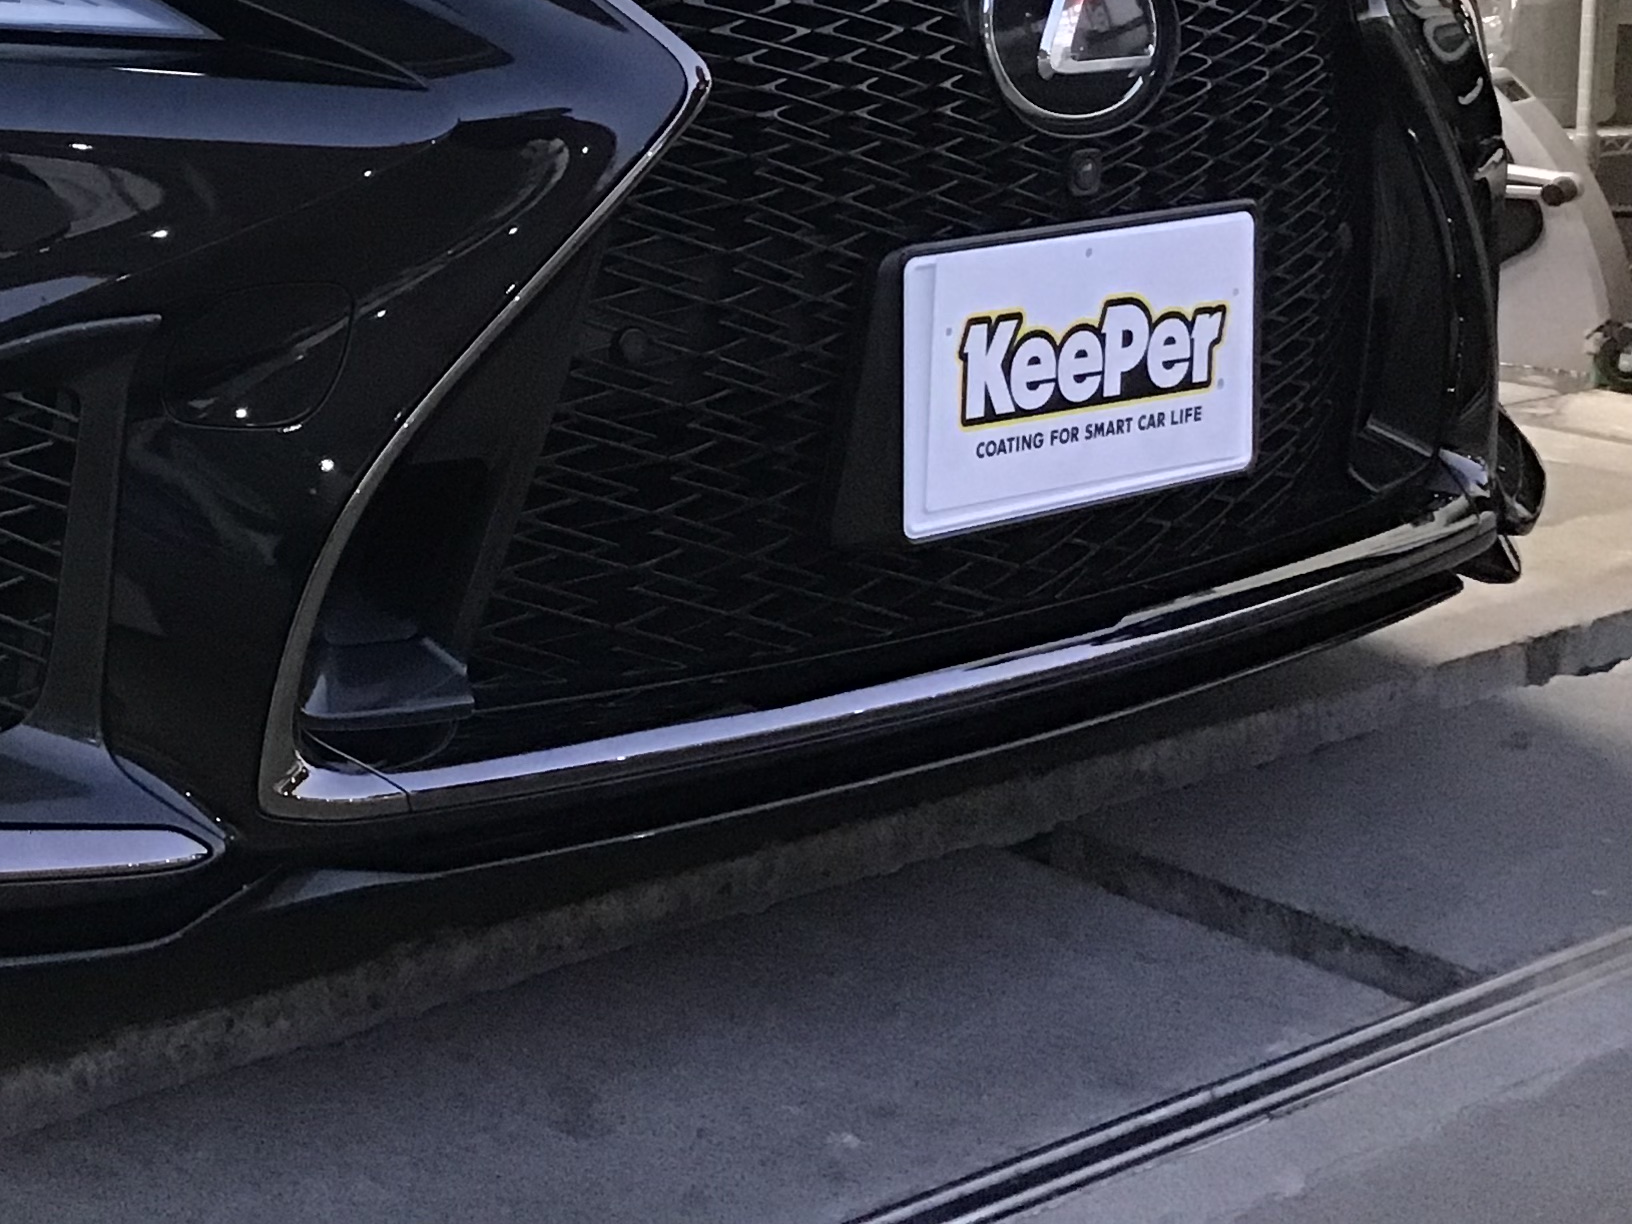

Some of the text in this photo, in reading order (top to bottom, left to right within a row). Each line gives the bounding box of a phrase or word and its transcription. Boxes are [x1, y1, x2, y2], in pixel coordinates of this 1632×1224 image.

[959, 295, 1227, 427] KeePer
[975, 405, 1203, 458] COATING FOR SMART CAR LIFE
